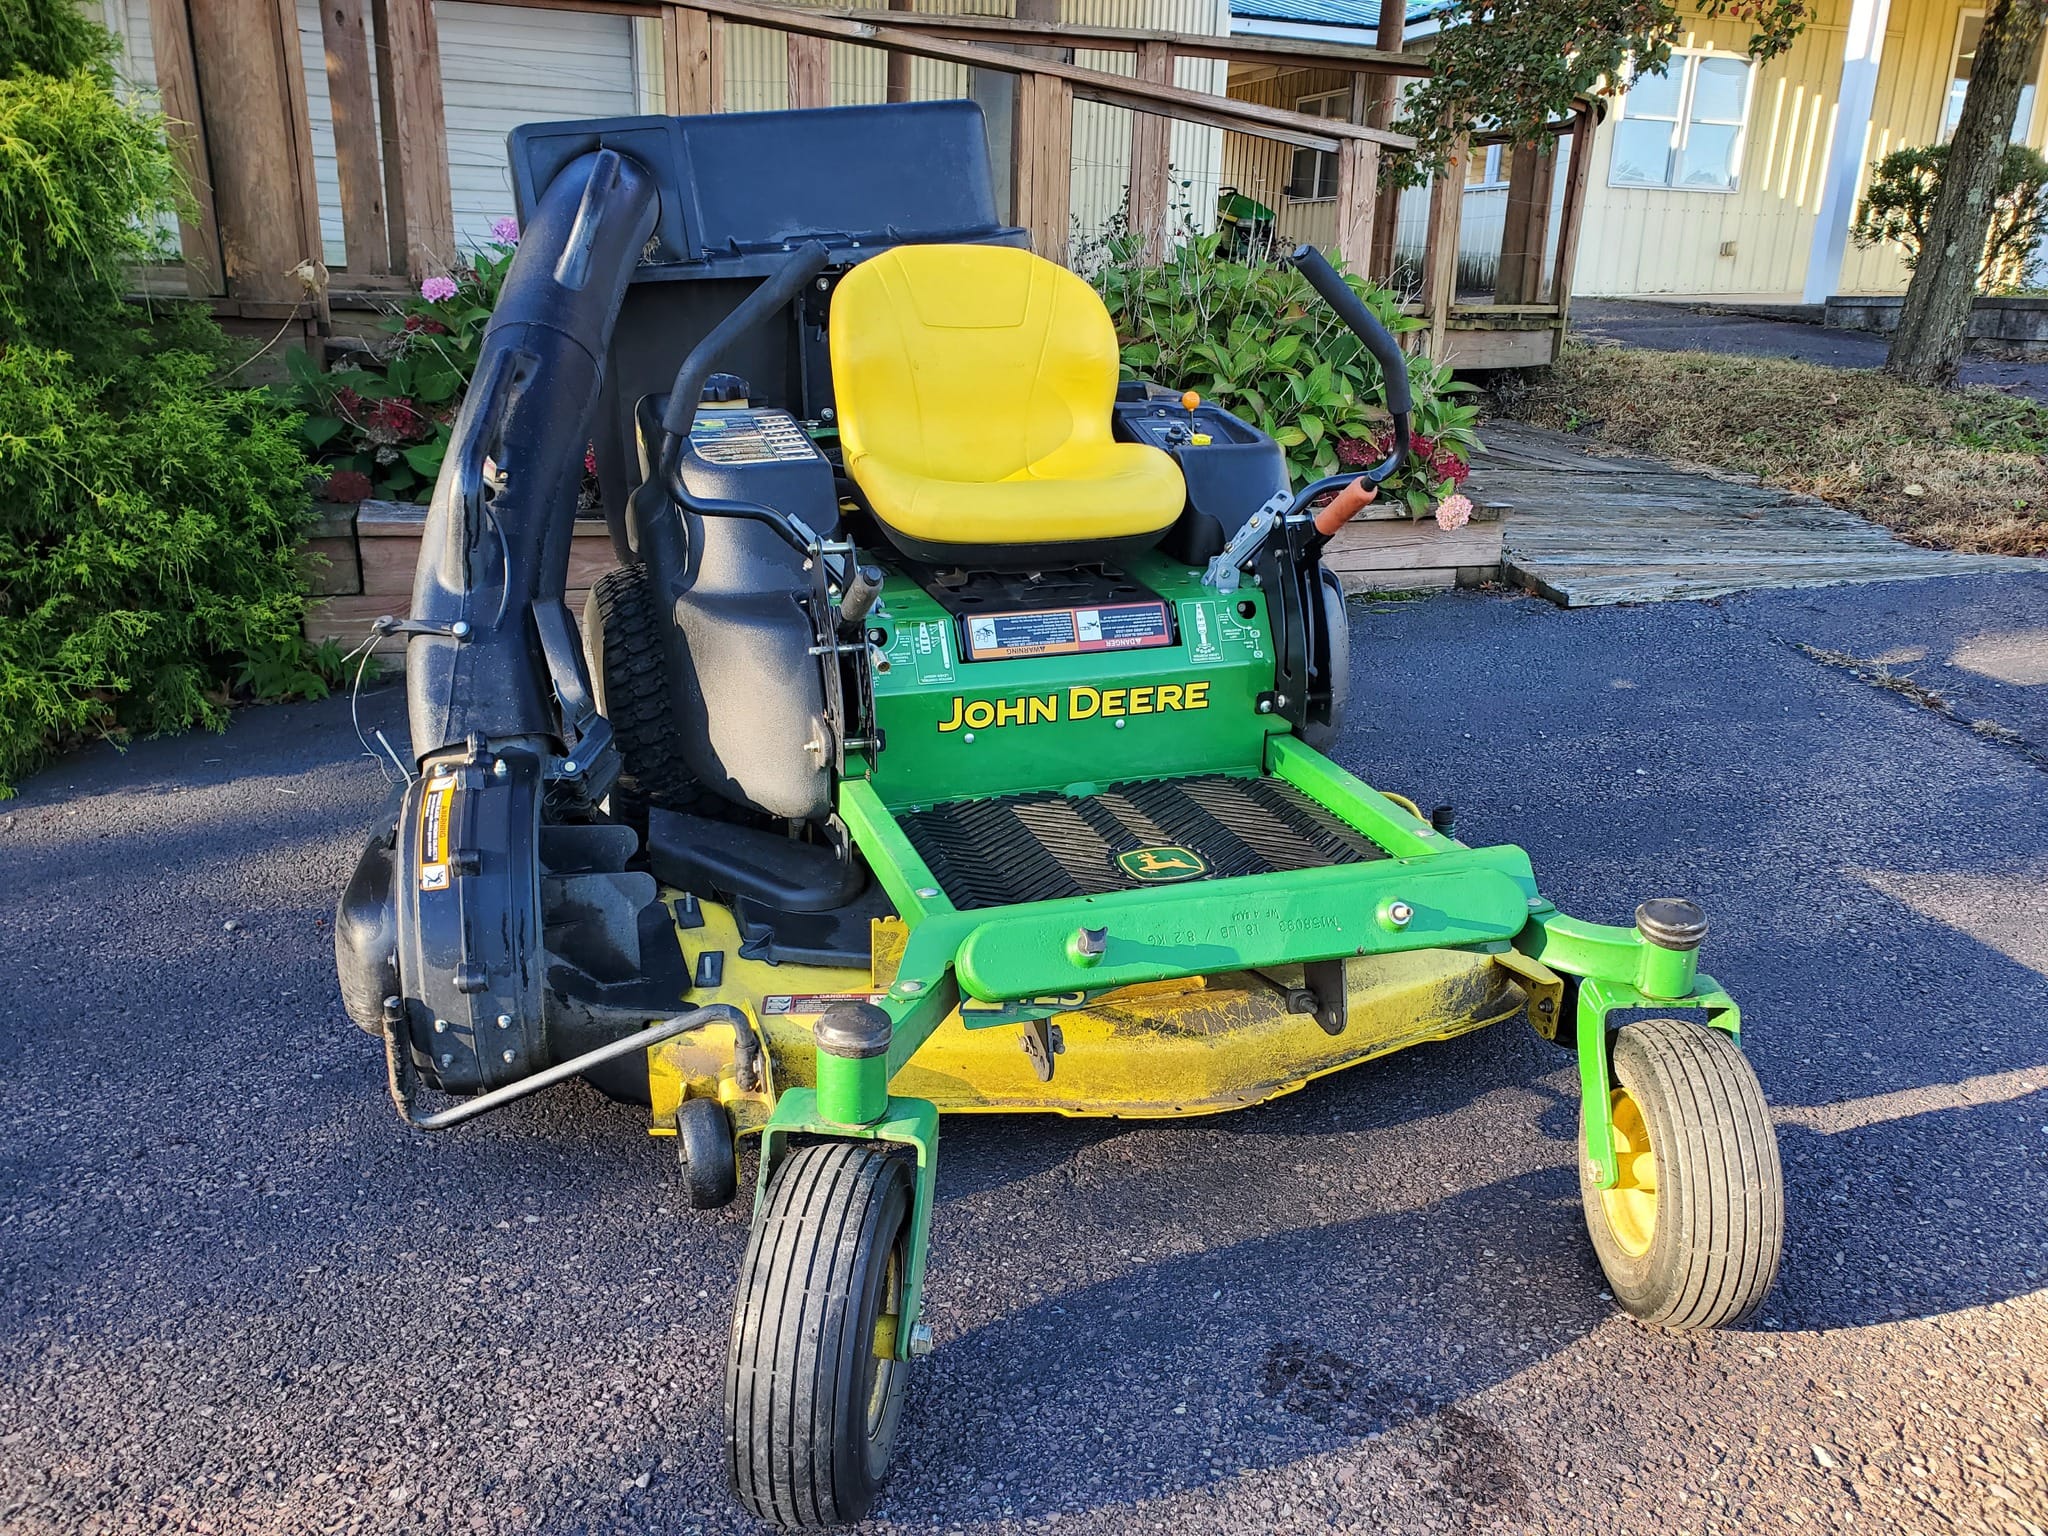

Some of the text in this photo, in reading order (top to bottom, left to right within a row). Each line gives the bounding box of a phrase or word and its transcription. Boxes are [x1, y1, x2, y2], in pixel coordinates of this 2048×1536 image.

[1105, 638, 1136, 647] DANGER
[1006, 645, 1041, 655] WARNING
[938, 681, 1211, 732] JOHN DEERE
[1147, 933, 1167, 946] KG
[1174, 929, 1196, 944] 8.2
[1220, 926, 1241, 940] LB
